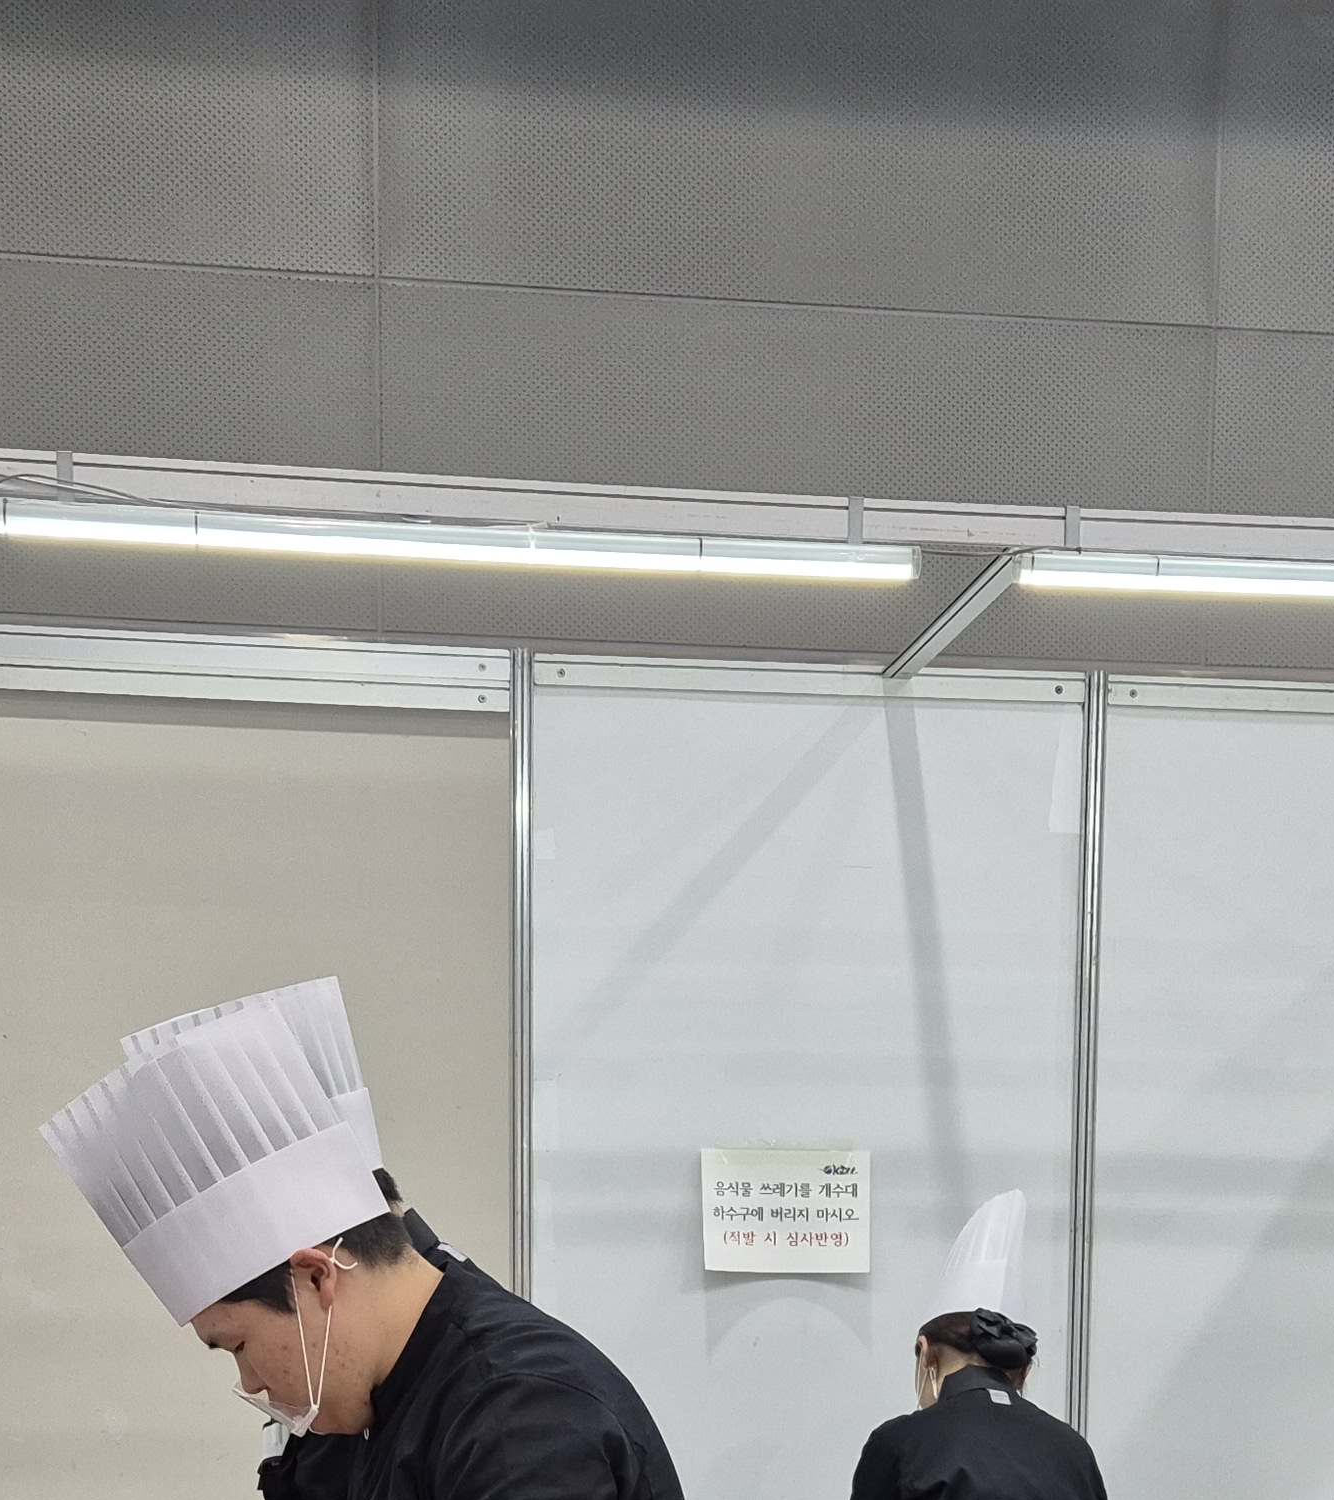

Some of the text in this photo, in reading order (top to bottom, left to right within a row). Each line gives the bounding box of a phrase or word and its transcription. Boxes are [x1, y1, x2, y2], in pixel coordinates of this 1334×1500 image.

[714, 1181, 858, 1198] 음식물 쓰레기를 개수대
[713, 1206, 764, 1222] 하수구에
[770, 1207, 809, 1222] 버리지
[723, 1231, 849, 1247] (적발 시 심사반영)
